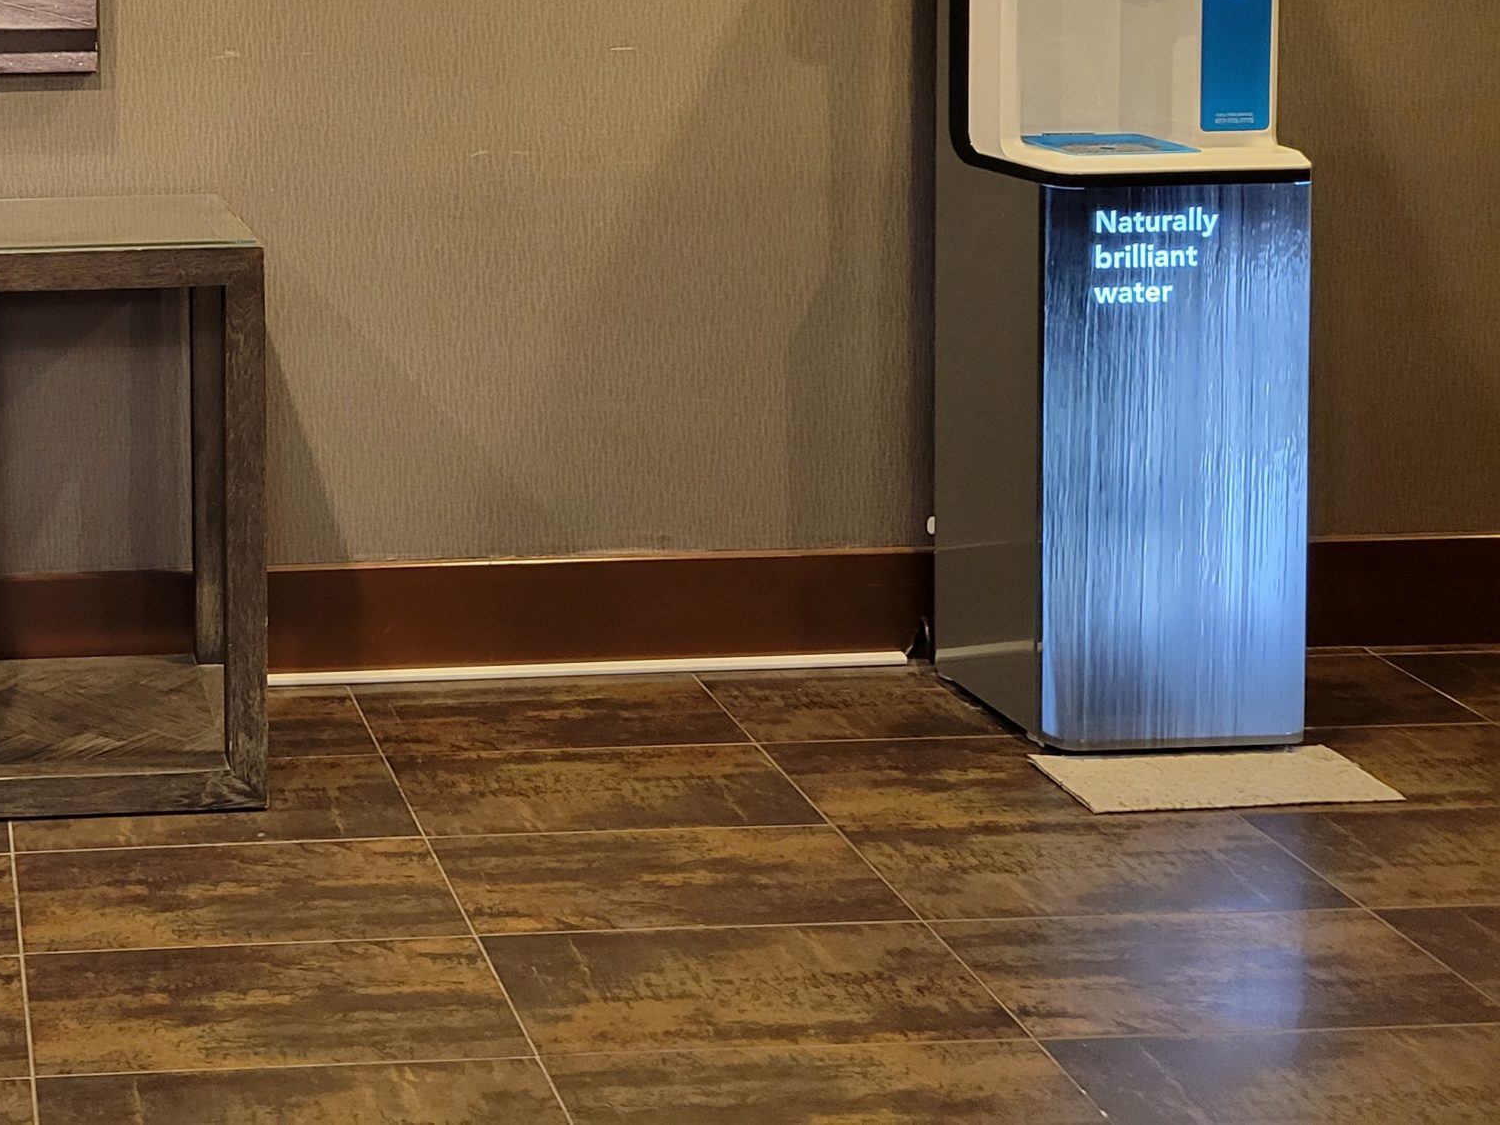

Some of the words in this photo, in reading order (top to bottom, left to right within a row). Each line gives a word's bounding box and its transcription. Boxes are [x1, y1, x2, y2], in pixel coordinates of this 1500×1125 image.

[1095, 206, 1219, 237] Naturally
[1094, 243, 1198, 269] brilliant
[1094, 282, 1173, 304] water
